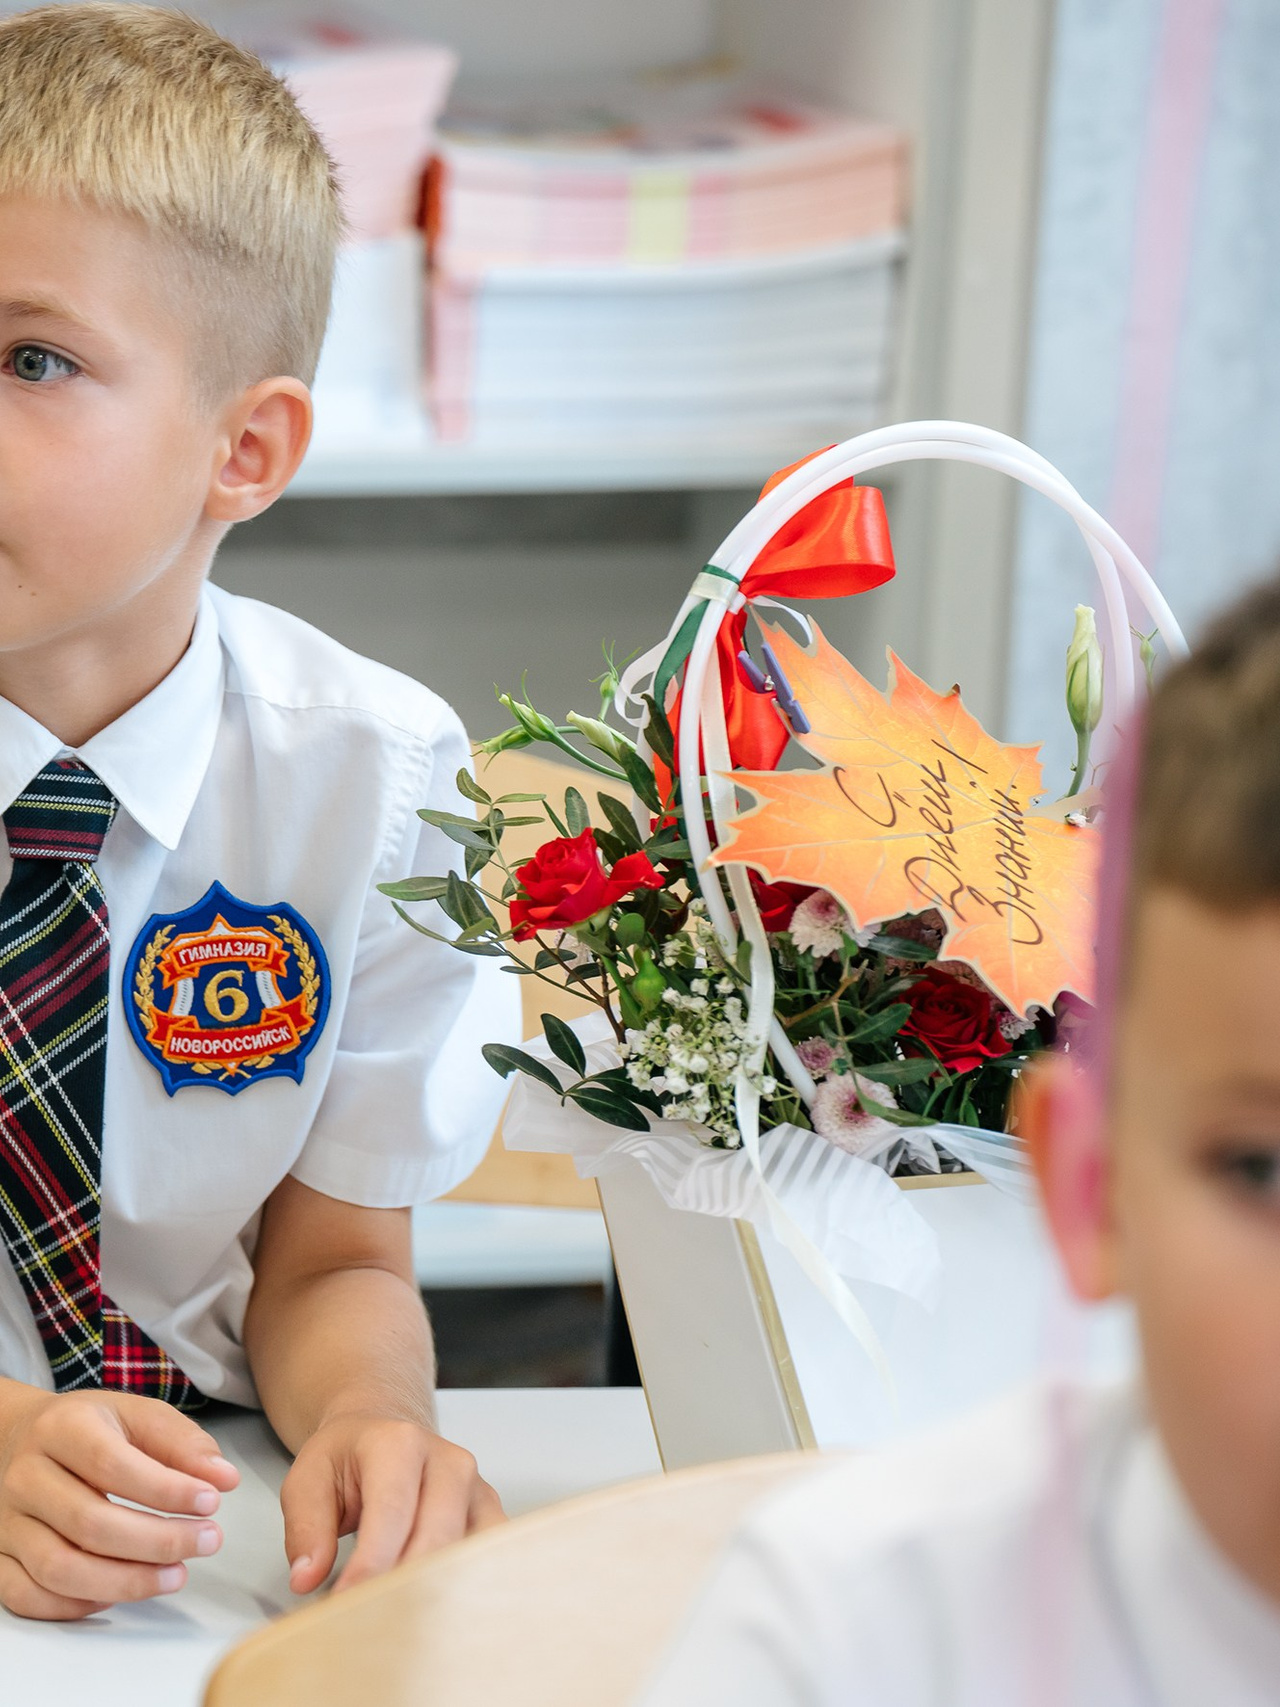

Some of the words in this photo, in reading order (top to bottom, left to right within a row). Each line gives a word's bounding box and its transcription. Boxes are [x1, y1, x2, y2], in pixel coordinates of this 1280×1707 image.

[833, 766, 896, 828] С
[178, 941, 267, 965] ГИМНАЗИЯ
[203, 969, 250, 1022] 6
[169, 1025, 292, 1054] НОВОРОССИЙСК
